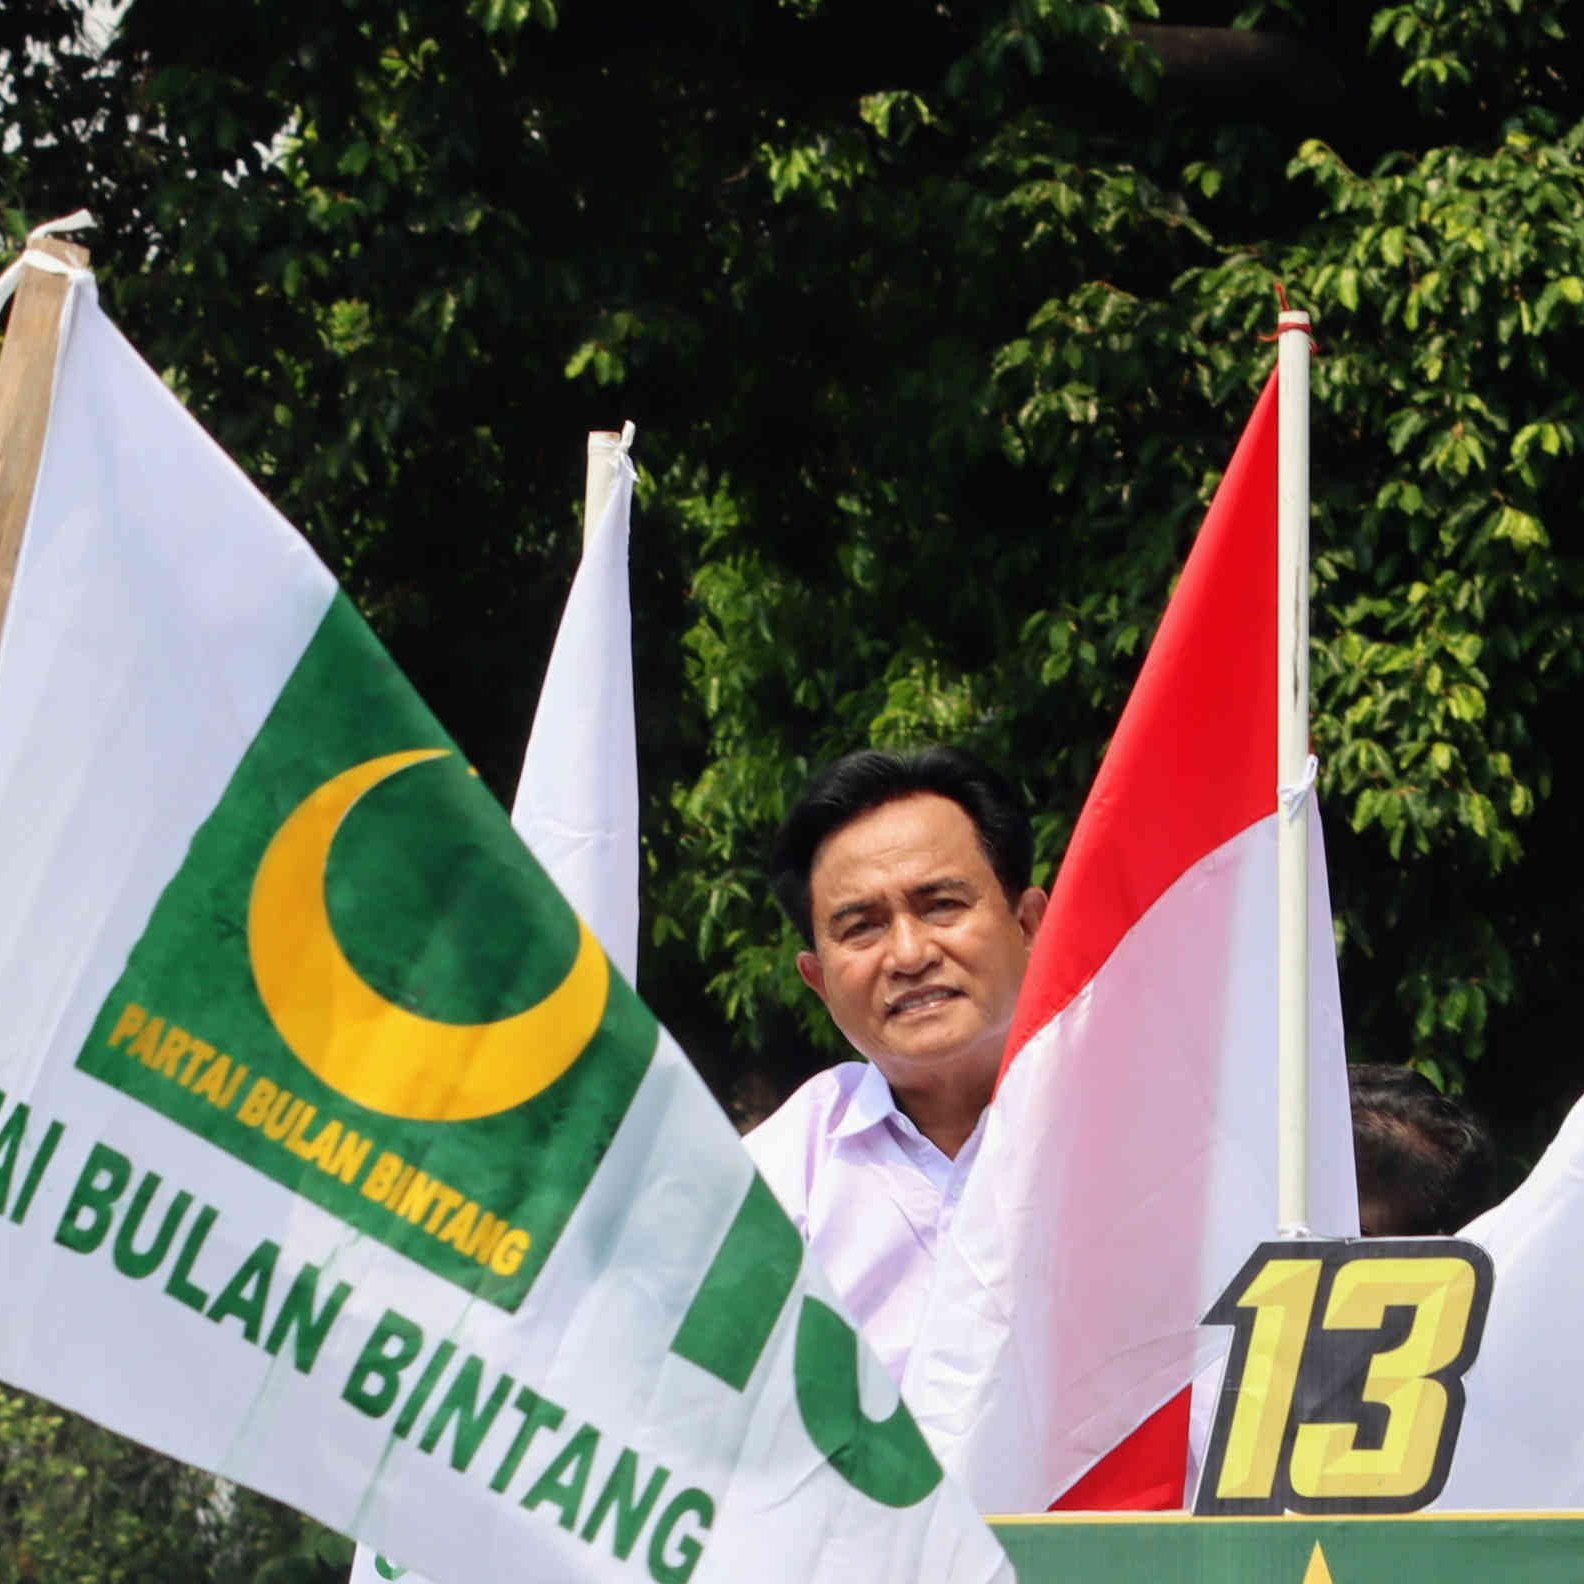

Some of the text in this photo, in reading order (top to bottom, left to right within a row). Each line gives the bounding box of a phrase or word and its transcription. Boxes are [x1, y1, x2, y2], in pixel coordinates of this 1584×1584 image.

[54, 1141, 353, 1376] BULAN
[108, 1003, 531, 1276] PARTAI BULAN BINTANG
[1215, 1257, 1476, 1499] 13
